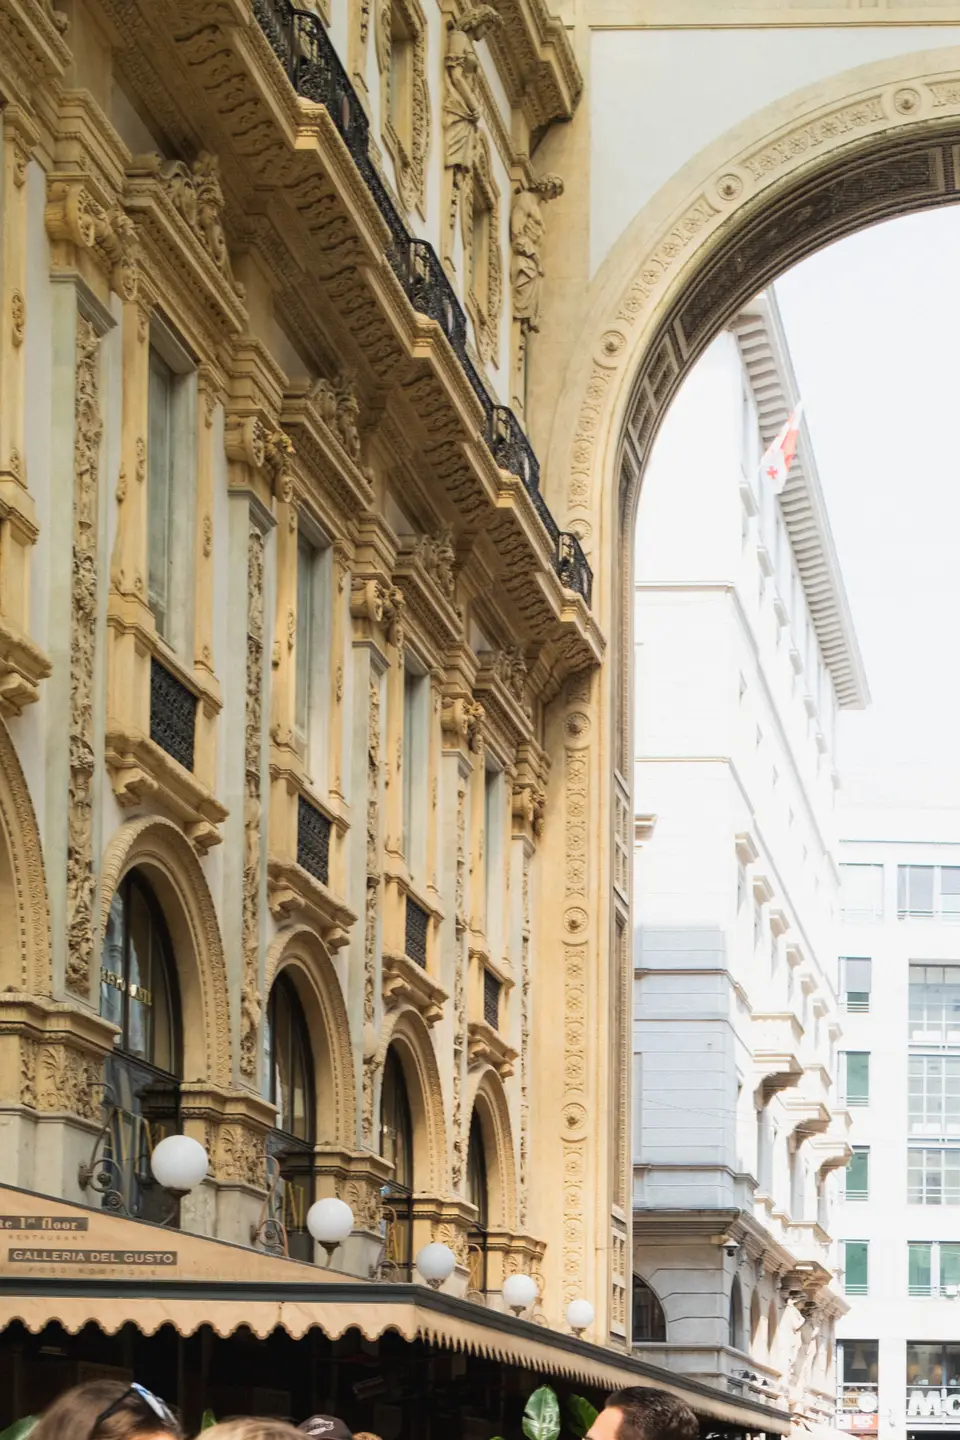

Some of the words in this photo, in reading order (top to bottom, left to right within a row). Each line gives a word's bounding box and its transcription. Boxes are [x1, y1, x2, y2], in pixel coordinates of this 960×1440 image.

[42, 1217, 78, 1230] floor
[8, 1233, 86, 1242] RESTAURANT
[13, 1250, 86, 1261] GALLERIA
[90, 1252, 119, 1262] DEL
[123, 1253, 174, 1264] GUSTO
